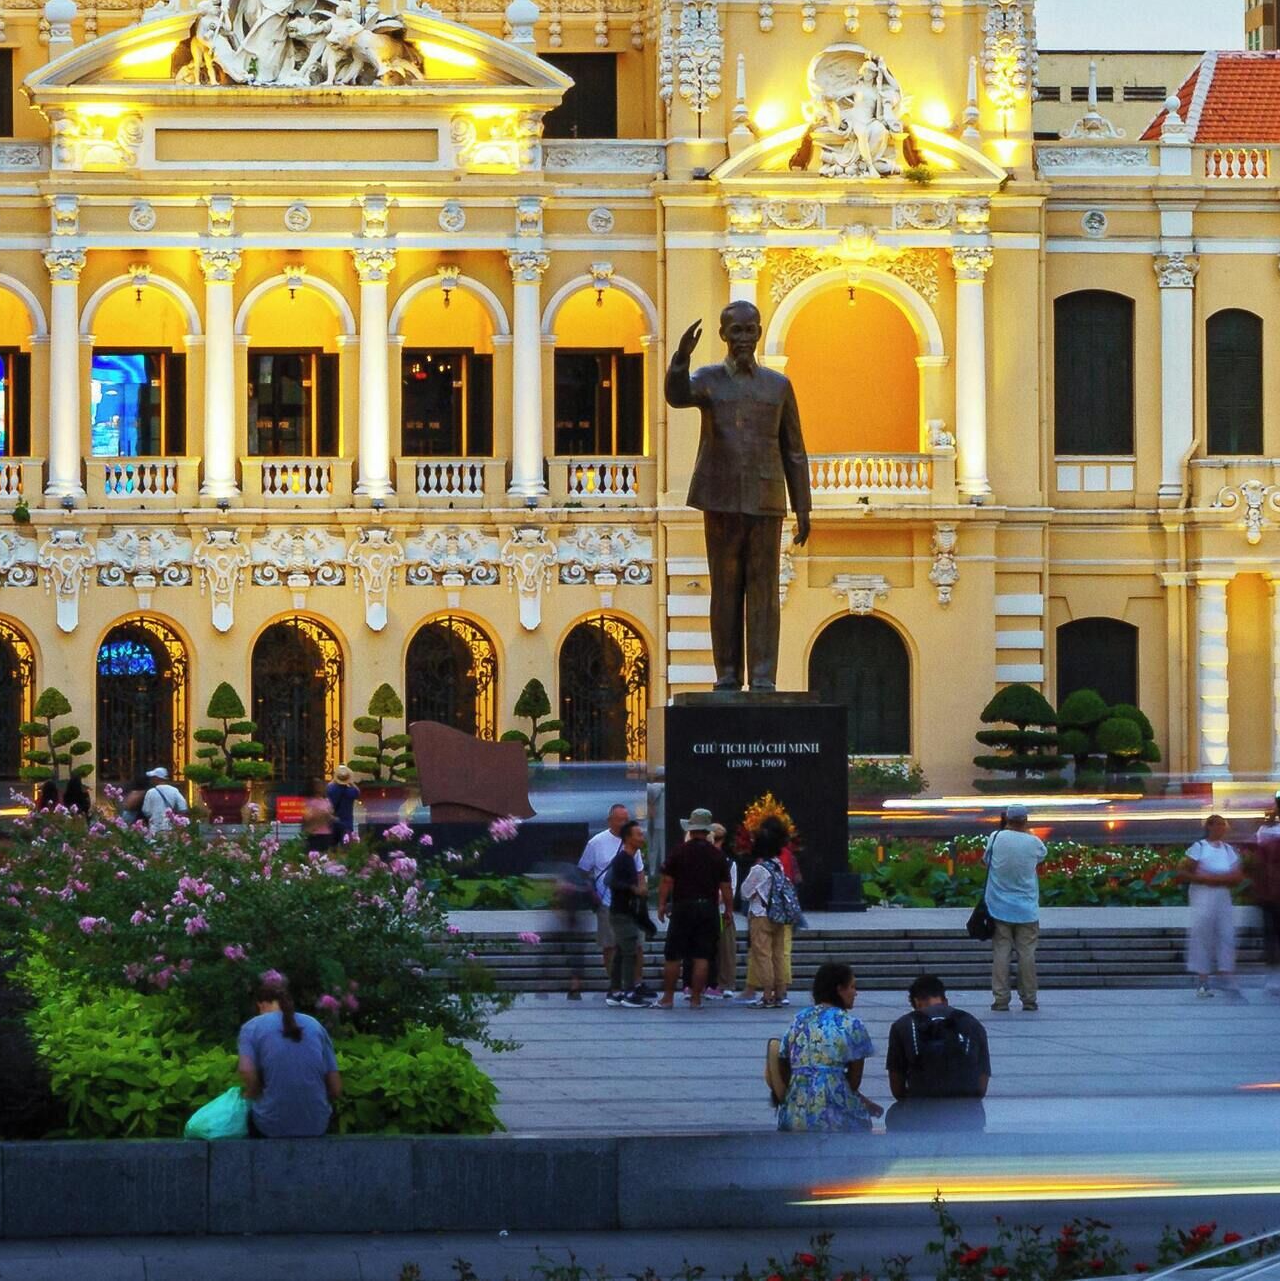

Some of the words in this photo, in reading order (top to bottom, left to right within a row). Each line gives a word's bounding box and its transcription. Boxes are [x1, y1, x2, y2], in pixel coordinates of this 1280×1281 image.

[788, 742, 820, 754] MINH
[726, 759, 753, 768] (1890
[761, 759, 787, 768] 1969)
